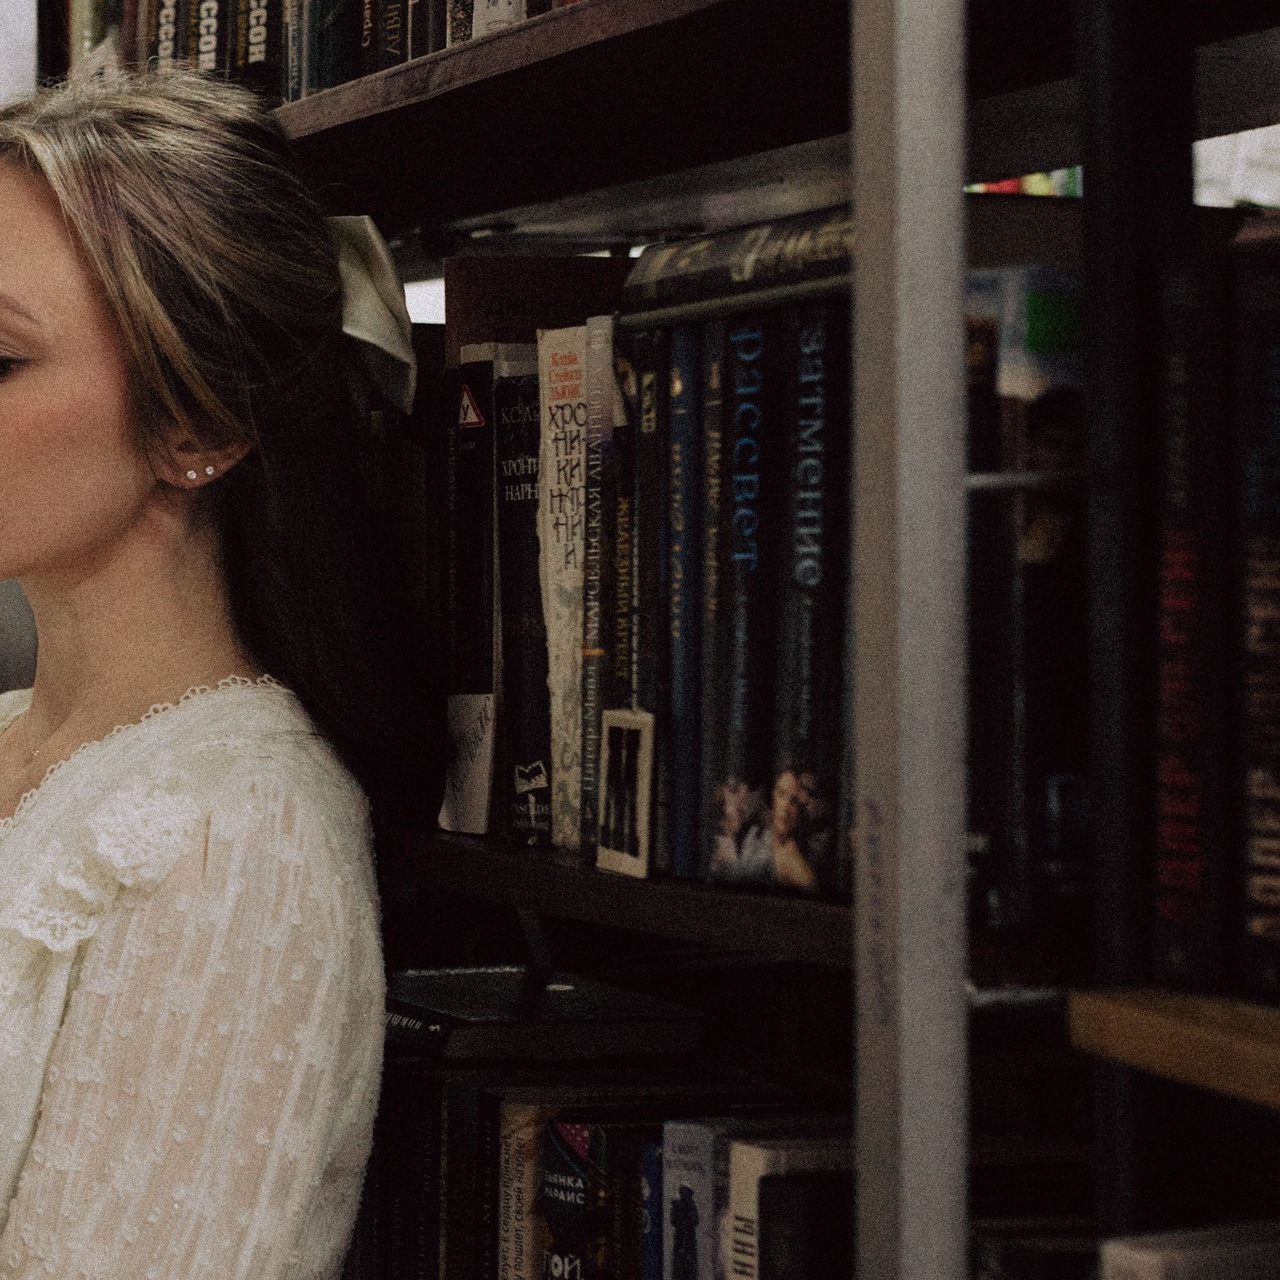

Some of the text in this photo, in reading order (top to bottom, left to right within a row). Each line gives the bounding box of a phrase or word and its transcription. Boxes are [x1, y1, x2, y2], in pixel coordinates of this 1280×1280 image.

[585, 485, 603, 641] МАРСЕЛЬСКАЯ
[729, 329, 764, 571] рассвет
[795, 326, 826, 587] затмение
